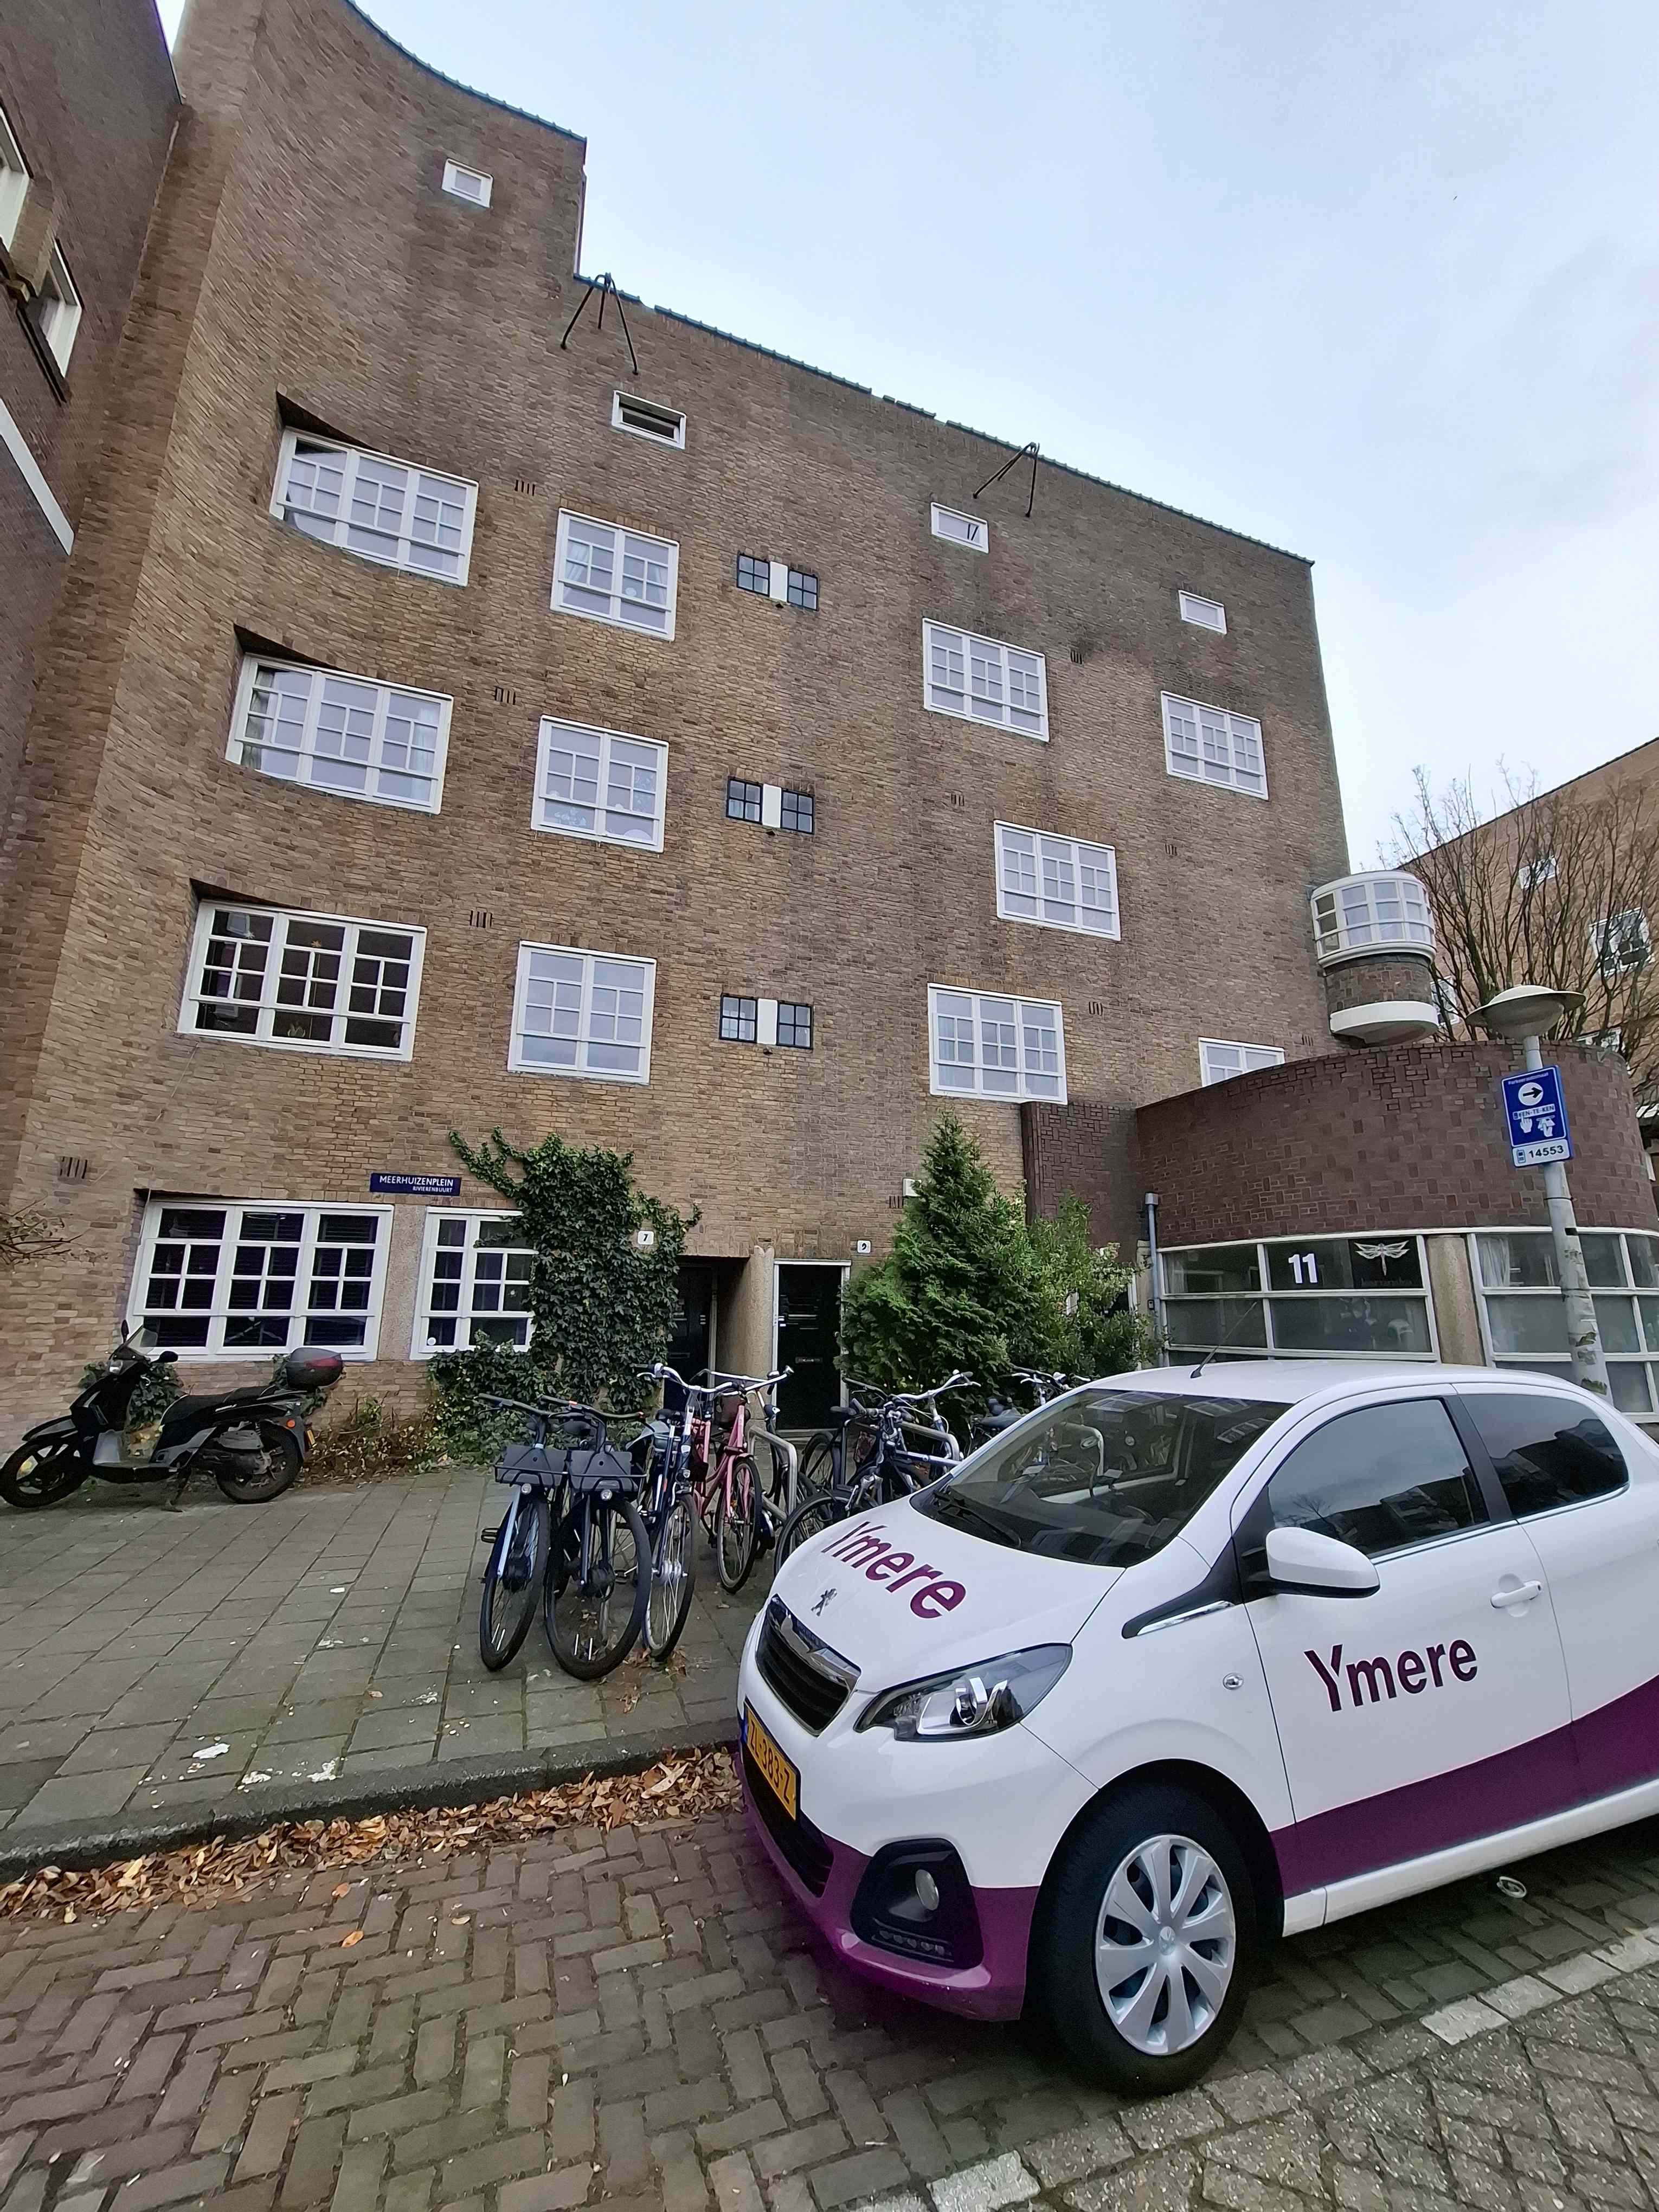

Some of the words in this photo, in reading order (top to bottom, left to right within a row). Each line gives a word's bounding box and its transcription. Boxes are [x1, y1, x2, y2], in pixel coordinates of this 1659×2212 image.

[1528, 1145, 1564, 1158] 14553
[380, 1175, 454, 1187] MEERHUIZENPLEIN
[644, 1233, 649, 1242] 7
[861, 1243, 867, 1251] 9
[1288, 1253, 1318, 1283] 11
[821, 1521, 967, 1619] Ymere
[1304, 1638, 1478, 1712] Ymere
[750, 1719, 790, 1805] ZL-383-Z
